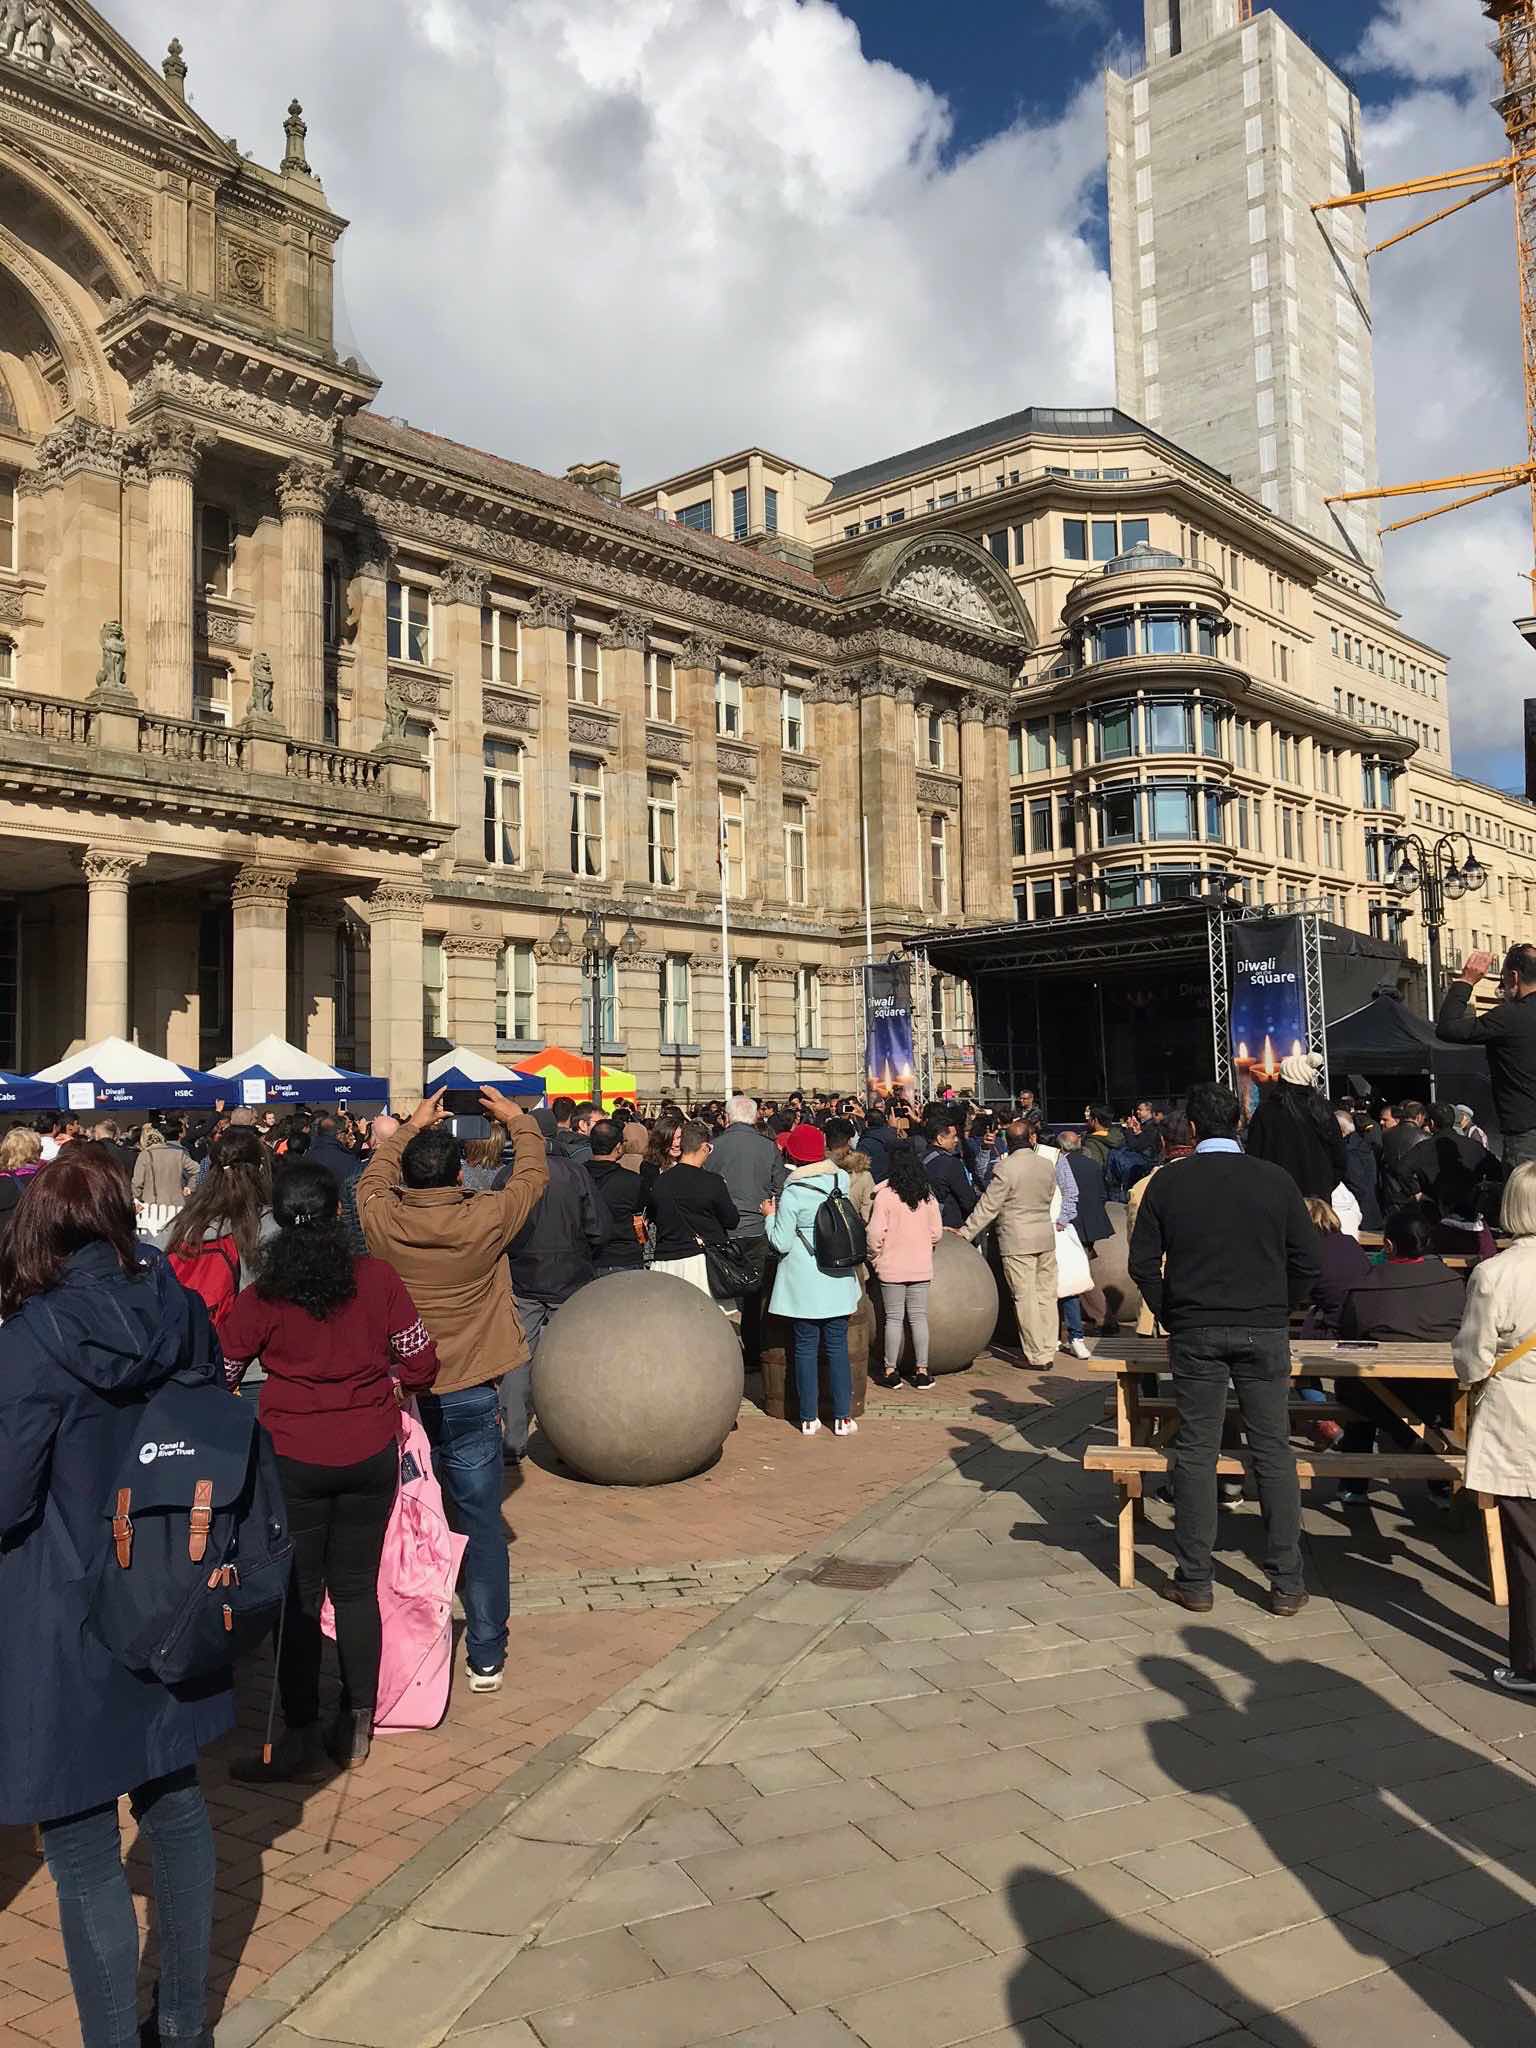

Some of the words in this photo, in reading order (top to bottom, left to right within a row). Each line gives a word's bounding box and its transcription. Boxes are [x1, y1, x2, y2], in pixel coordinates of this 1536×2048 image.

[1237, 957, 1276, 973] Diwali
[1250, 973, 1296, 986] square
[874, 1008, 906, 1019] square
[174, 1089, 194, 1097] HSBC
[175, 1448, 195, 1456] Trust
